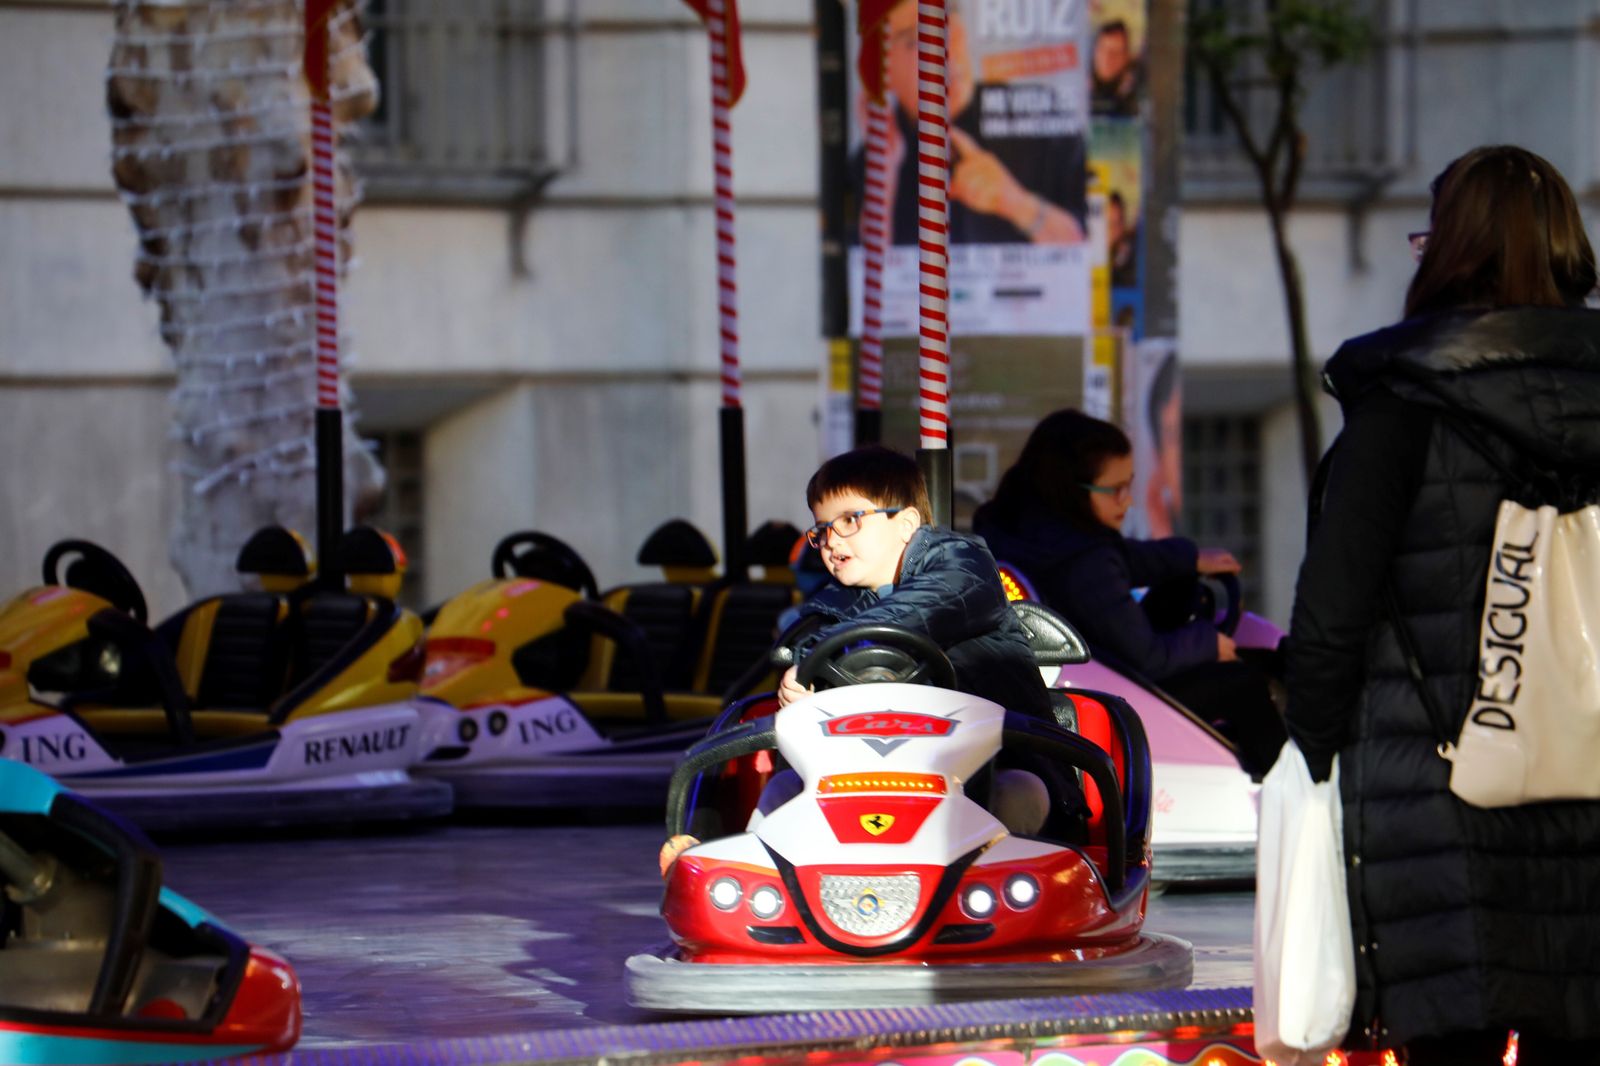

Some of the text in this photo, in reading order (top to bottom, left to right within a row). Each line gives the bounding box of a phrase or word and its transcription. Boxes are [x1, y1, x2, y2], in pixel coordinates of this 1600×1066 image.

[978, 0, 1076, 37] RUIZ
[1471, 530, 1539, 731] DESIGUAL
[517, 708, 577, 744] ING
[836, 714, 936, 734] Cars
[21, 731, 86, 764] ING
[304, 723, 411, 765] RENAULT
